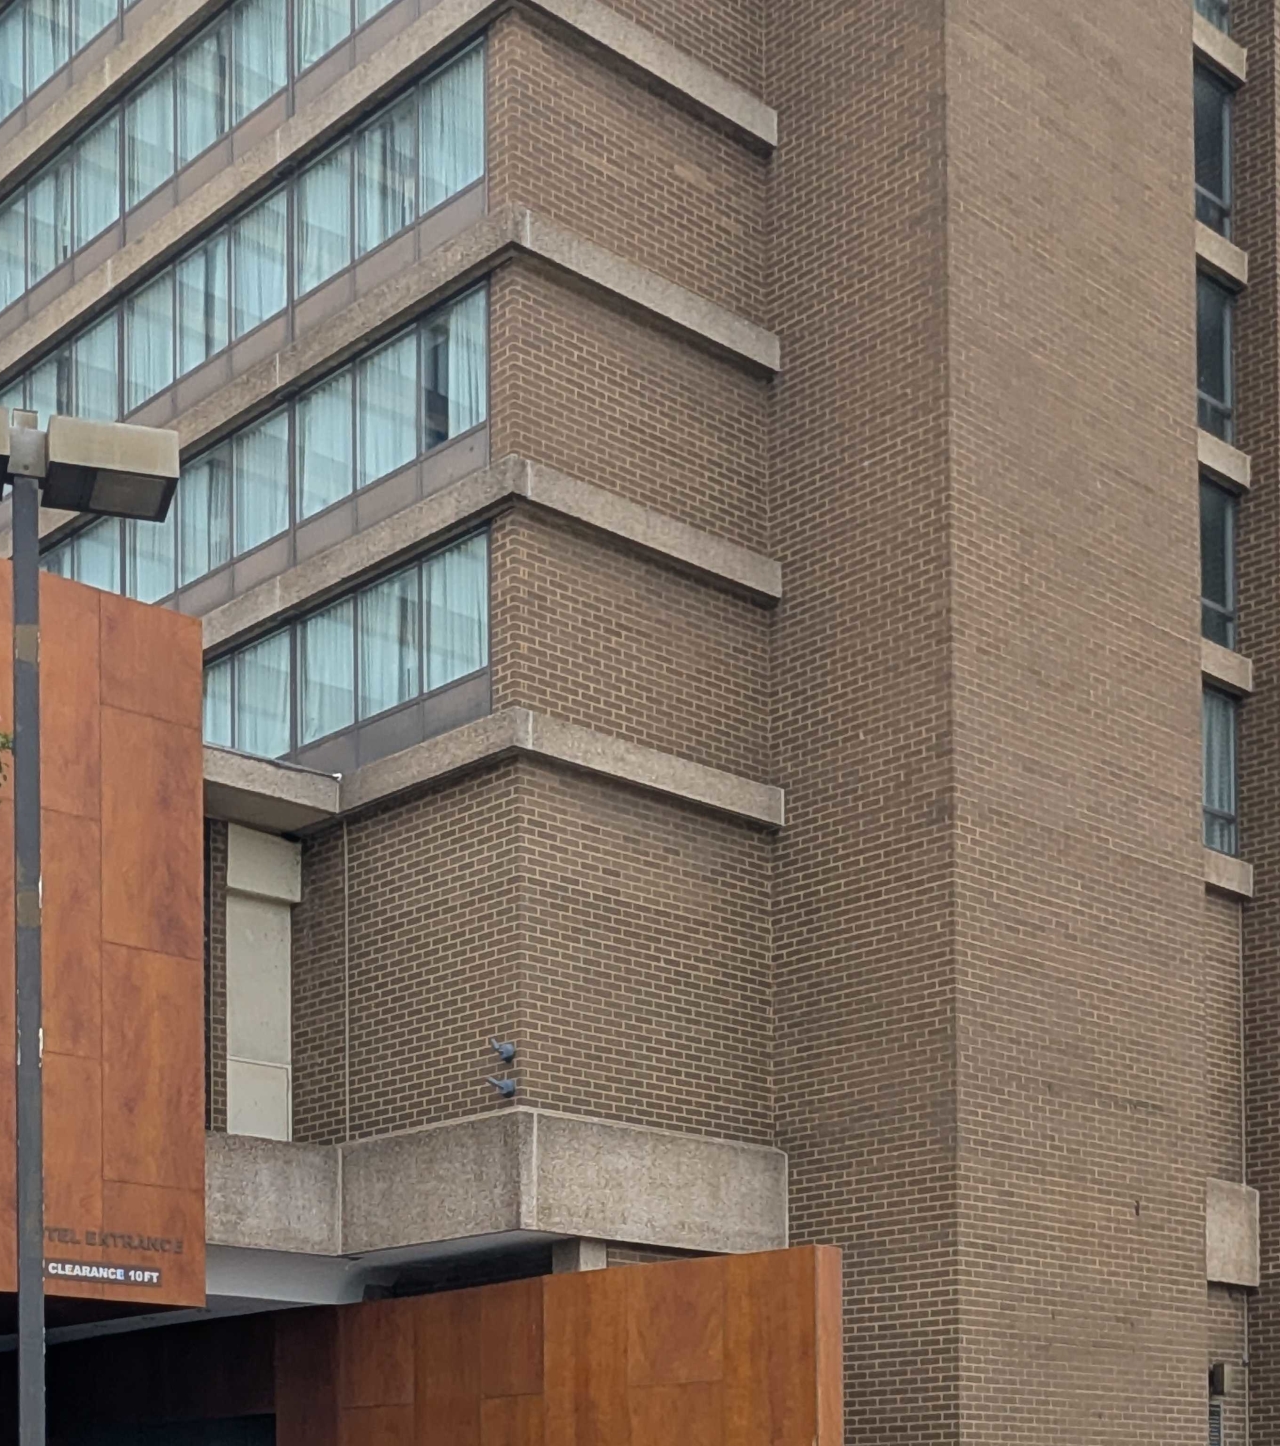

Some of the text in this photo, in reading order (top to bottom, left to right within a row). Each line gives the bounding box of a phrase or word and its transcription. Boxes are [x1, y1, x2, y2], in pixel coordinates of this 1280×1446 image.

[44, 1227, 184, 1254] TEL ENTRANCE
[47, 1262, 125, 1281] CLEARANCE
